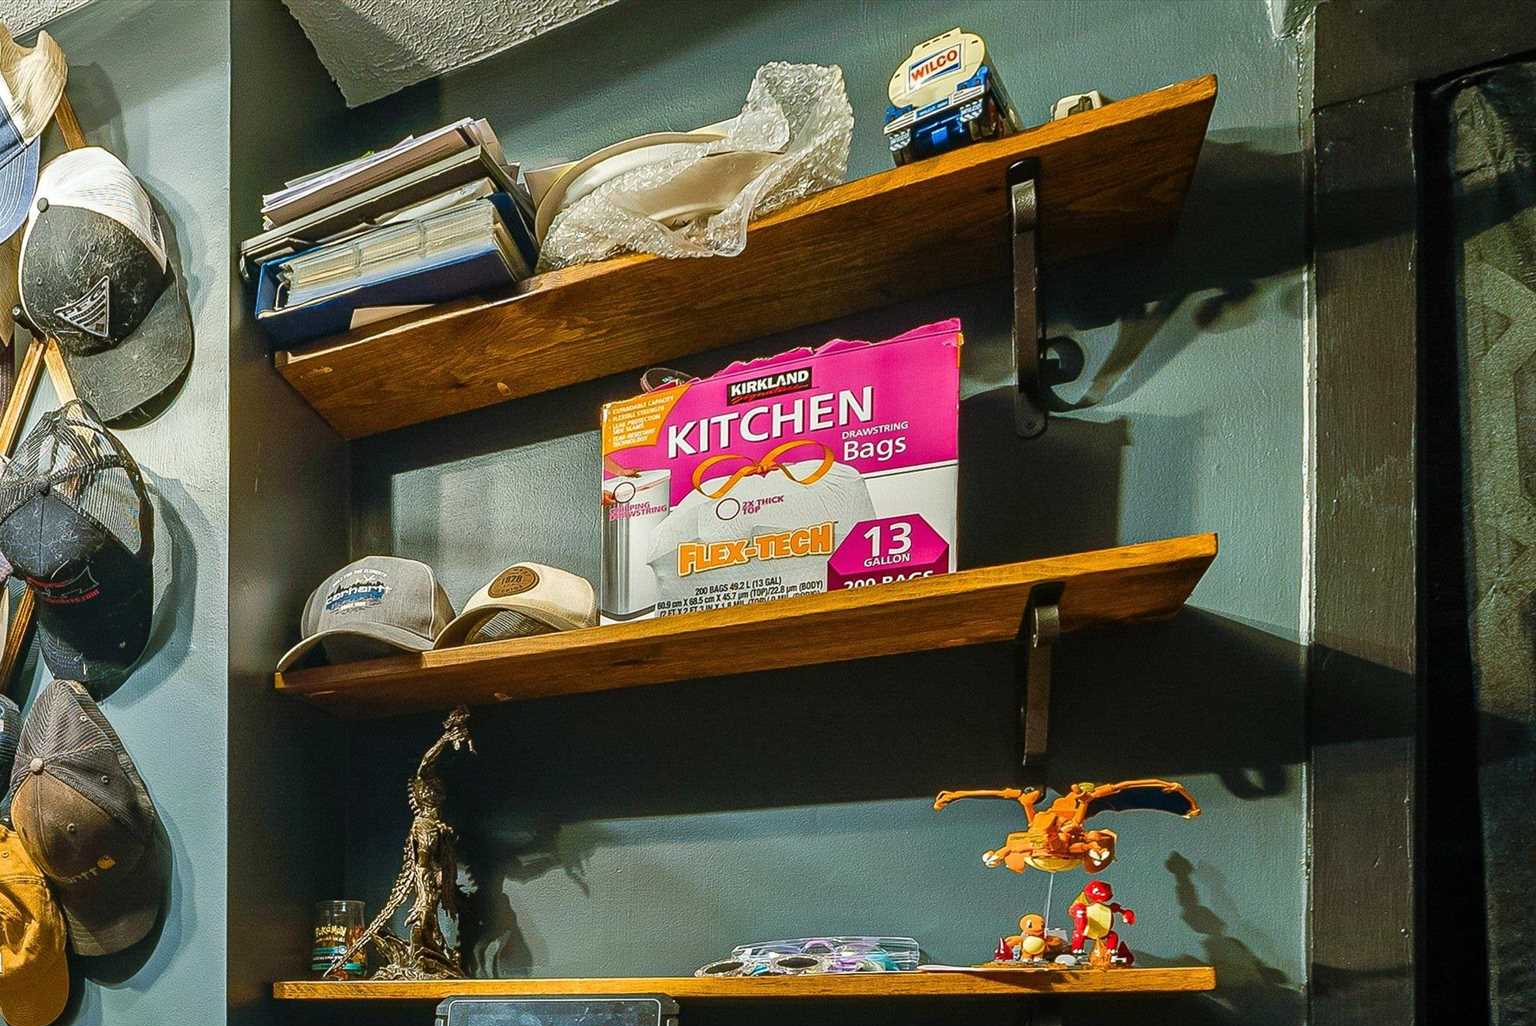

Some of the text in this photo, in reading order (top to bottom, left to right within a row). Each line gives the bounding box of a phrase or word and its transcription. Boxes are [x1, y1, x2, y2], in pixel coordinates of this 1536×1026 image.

[911, 50, 958, 80] WILCO
[731, 370, 809, 397] KIRKLAND
[667, 386, 873, 459] KITCHEN
[842, 421, 909, 439] DRAWSTRING
[844, 432, 907, 462] Bags
[742, 496, 784, 509] 2X THICK
[743, 506, 760, 516] TOP
[677, 521, 836, 577] FLEX-TECH
[864, 522, 911, 556] 13
[864, 552, 911, 568] GALLON
[695, 586, 708, 596] 200
[710, 584, 729, 594] BAGS
[798, 580, 823, 593] (BODY)
